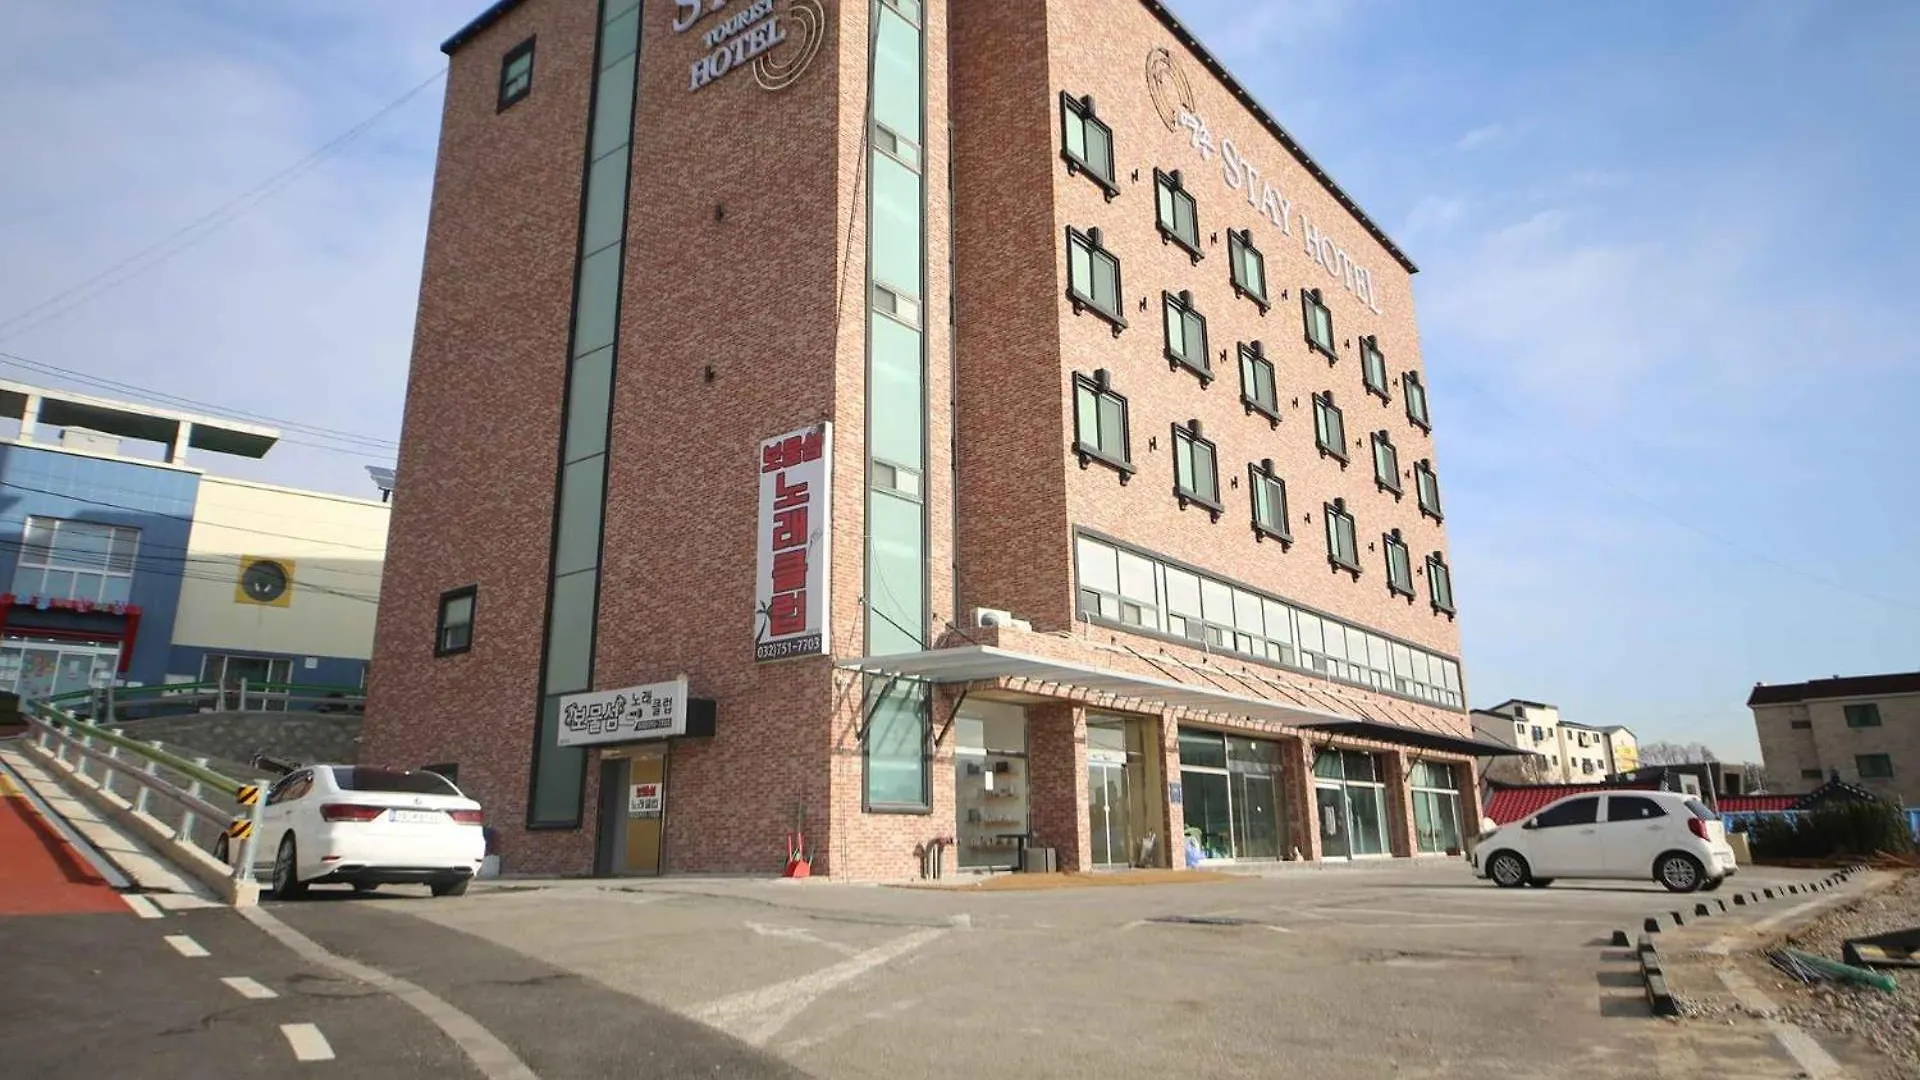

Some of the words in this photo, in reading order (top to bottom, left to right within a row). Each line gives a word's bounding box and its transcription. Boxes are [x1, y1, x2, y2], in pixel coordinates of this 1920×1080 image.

[688, 18, 787, 92] HOTEL
[703, 0, 774, 47] TOURIST
[1220, 138, 1290, 236] STAY
[1300, 214, 1382, 315] HOTEL
[769, 472, 810, 637] 노래클럽
[757, 641, 821, 658] 032)751-7703
